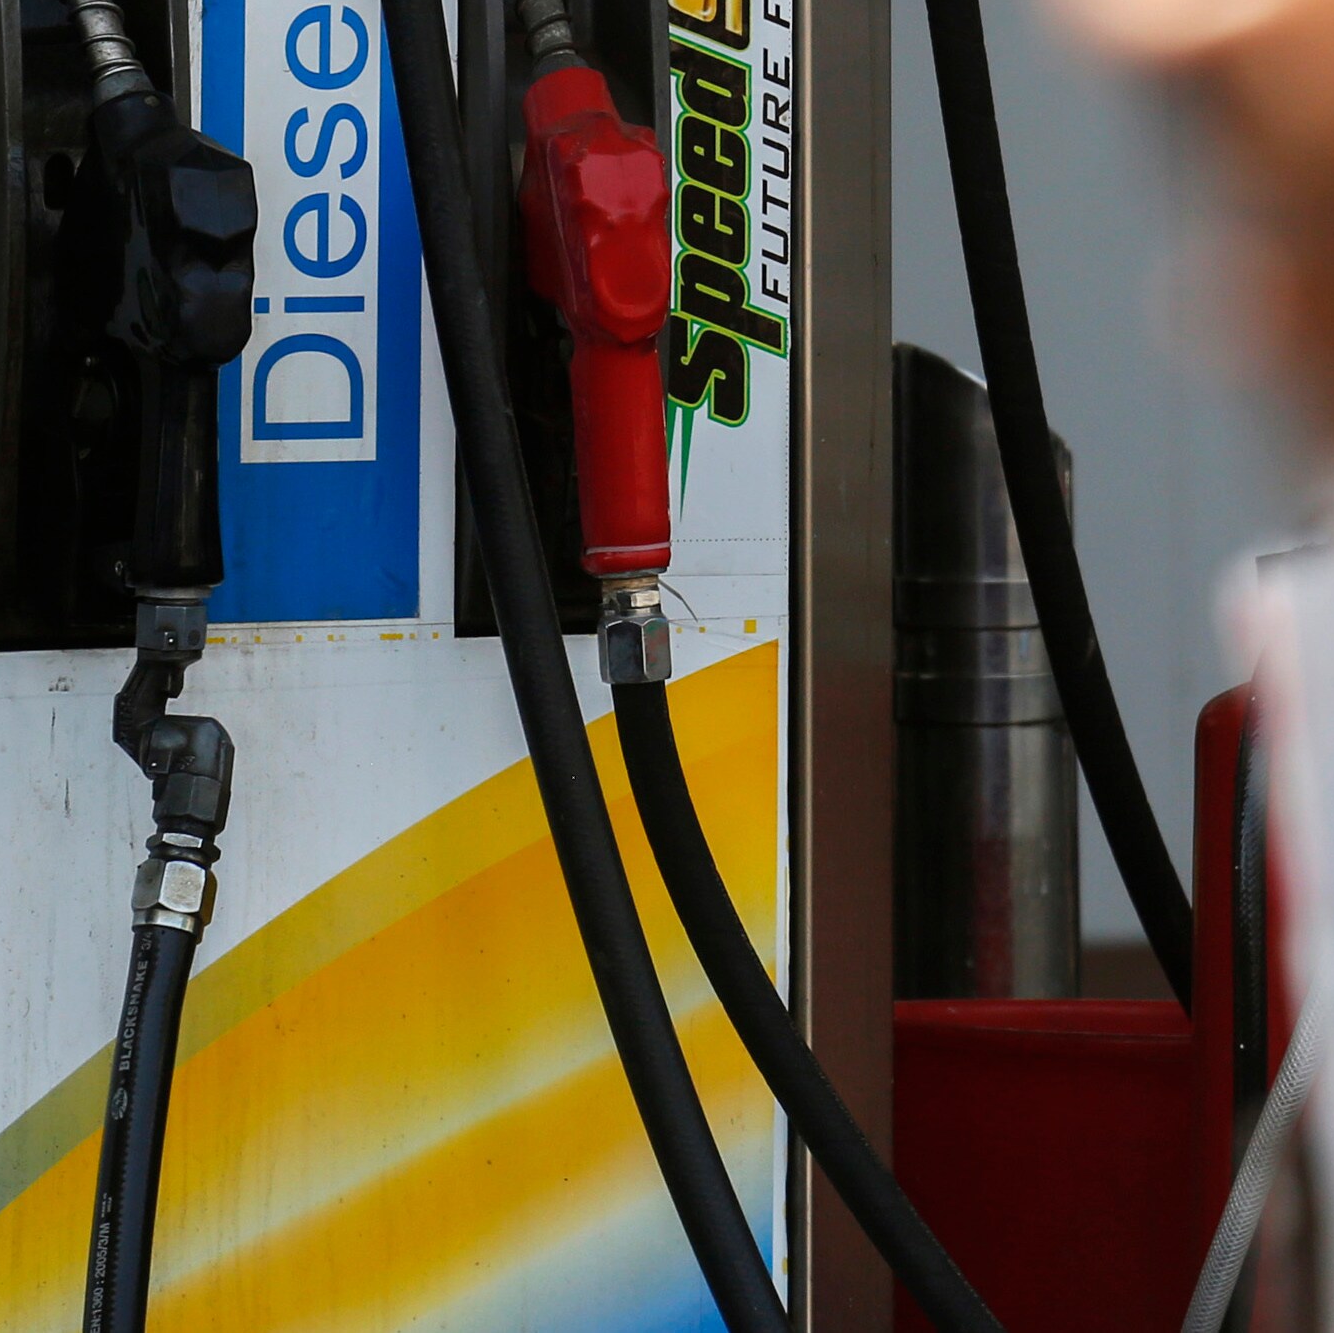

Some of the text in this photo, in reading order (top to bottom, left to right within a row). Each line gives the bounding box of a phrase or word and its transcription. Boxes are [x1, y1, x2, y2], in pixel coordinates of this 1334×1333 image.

[667, 32, 788, 428] Speed
[762, 48, 790, 304] FUTURE
[119, 960, 148, 1071] BLACKSNAKE
